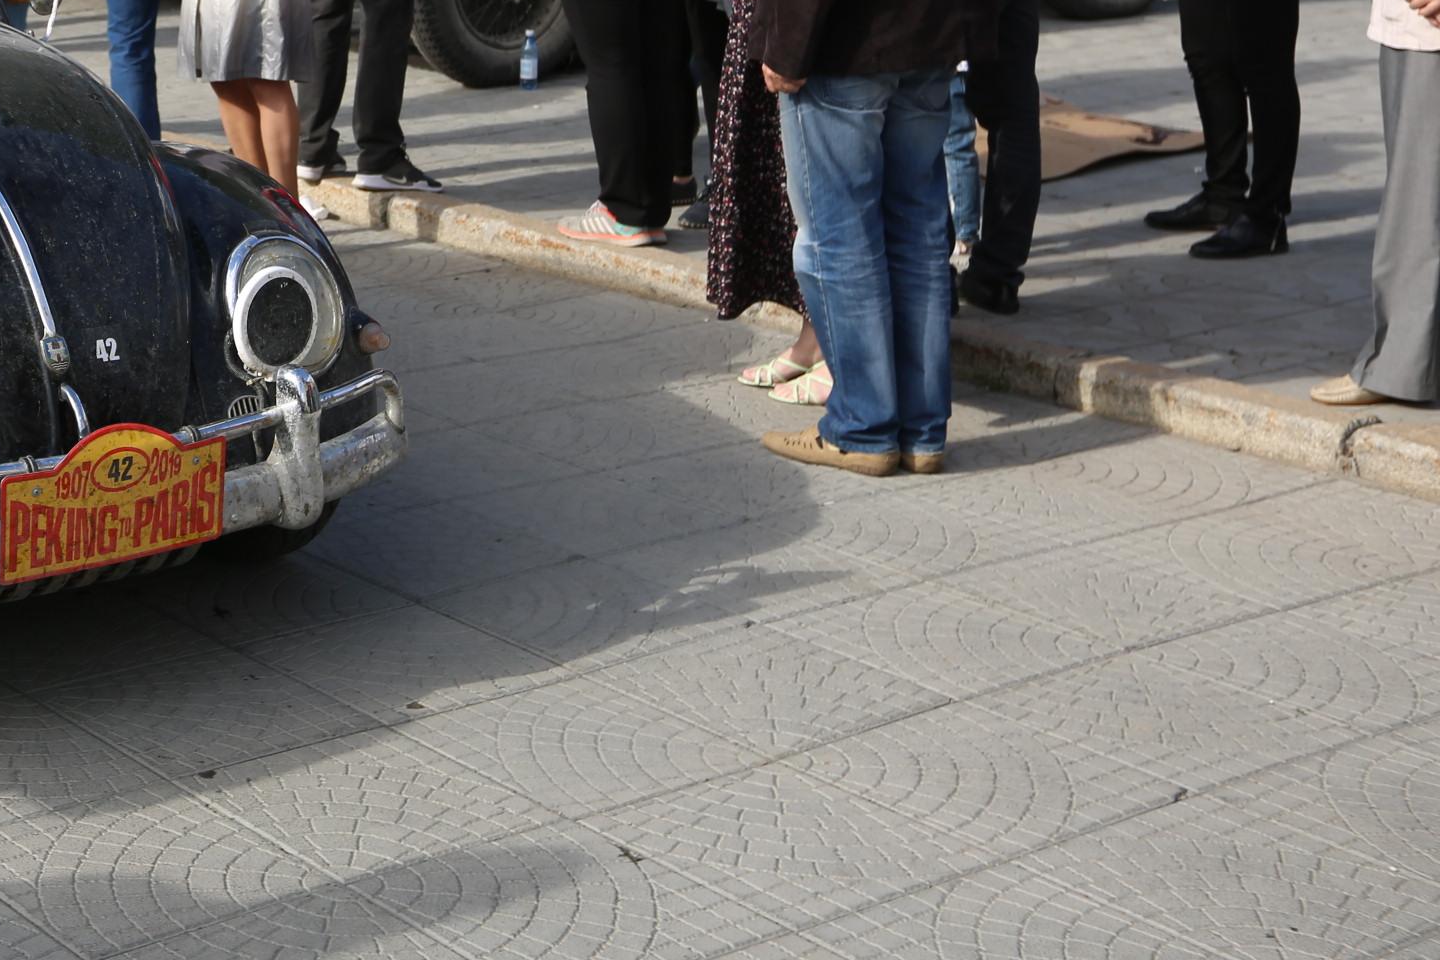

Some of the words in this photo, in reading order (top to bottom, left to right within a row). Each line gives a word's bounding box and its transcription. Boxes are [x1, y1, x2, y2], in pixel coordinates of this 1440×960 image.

[95, 337, 120, 362] 42
[54, 460, 92, 500] 1907
[107, 456, 134, 483] 42
[148, 447, 181, 486] 2019
[9, 500, 120, 573] PEKING
[132, 460, 218, 548] PARIS
